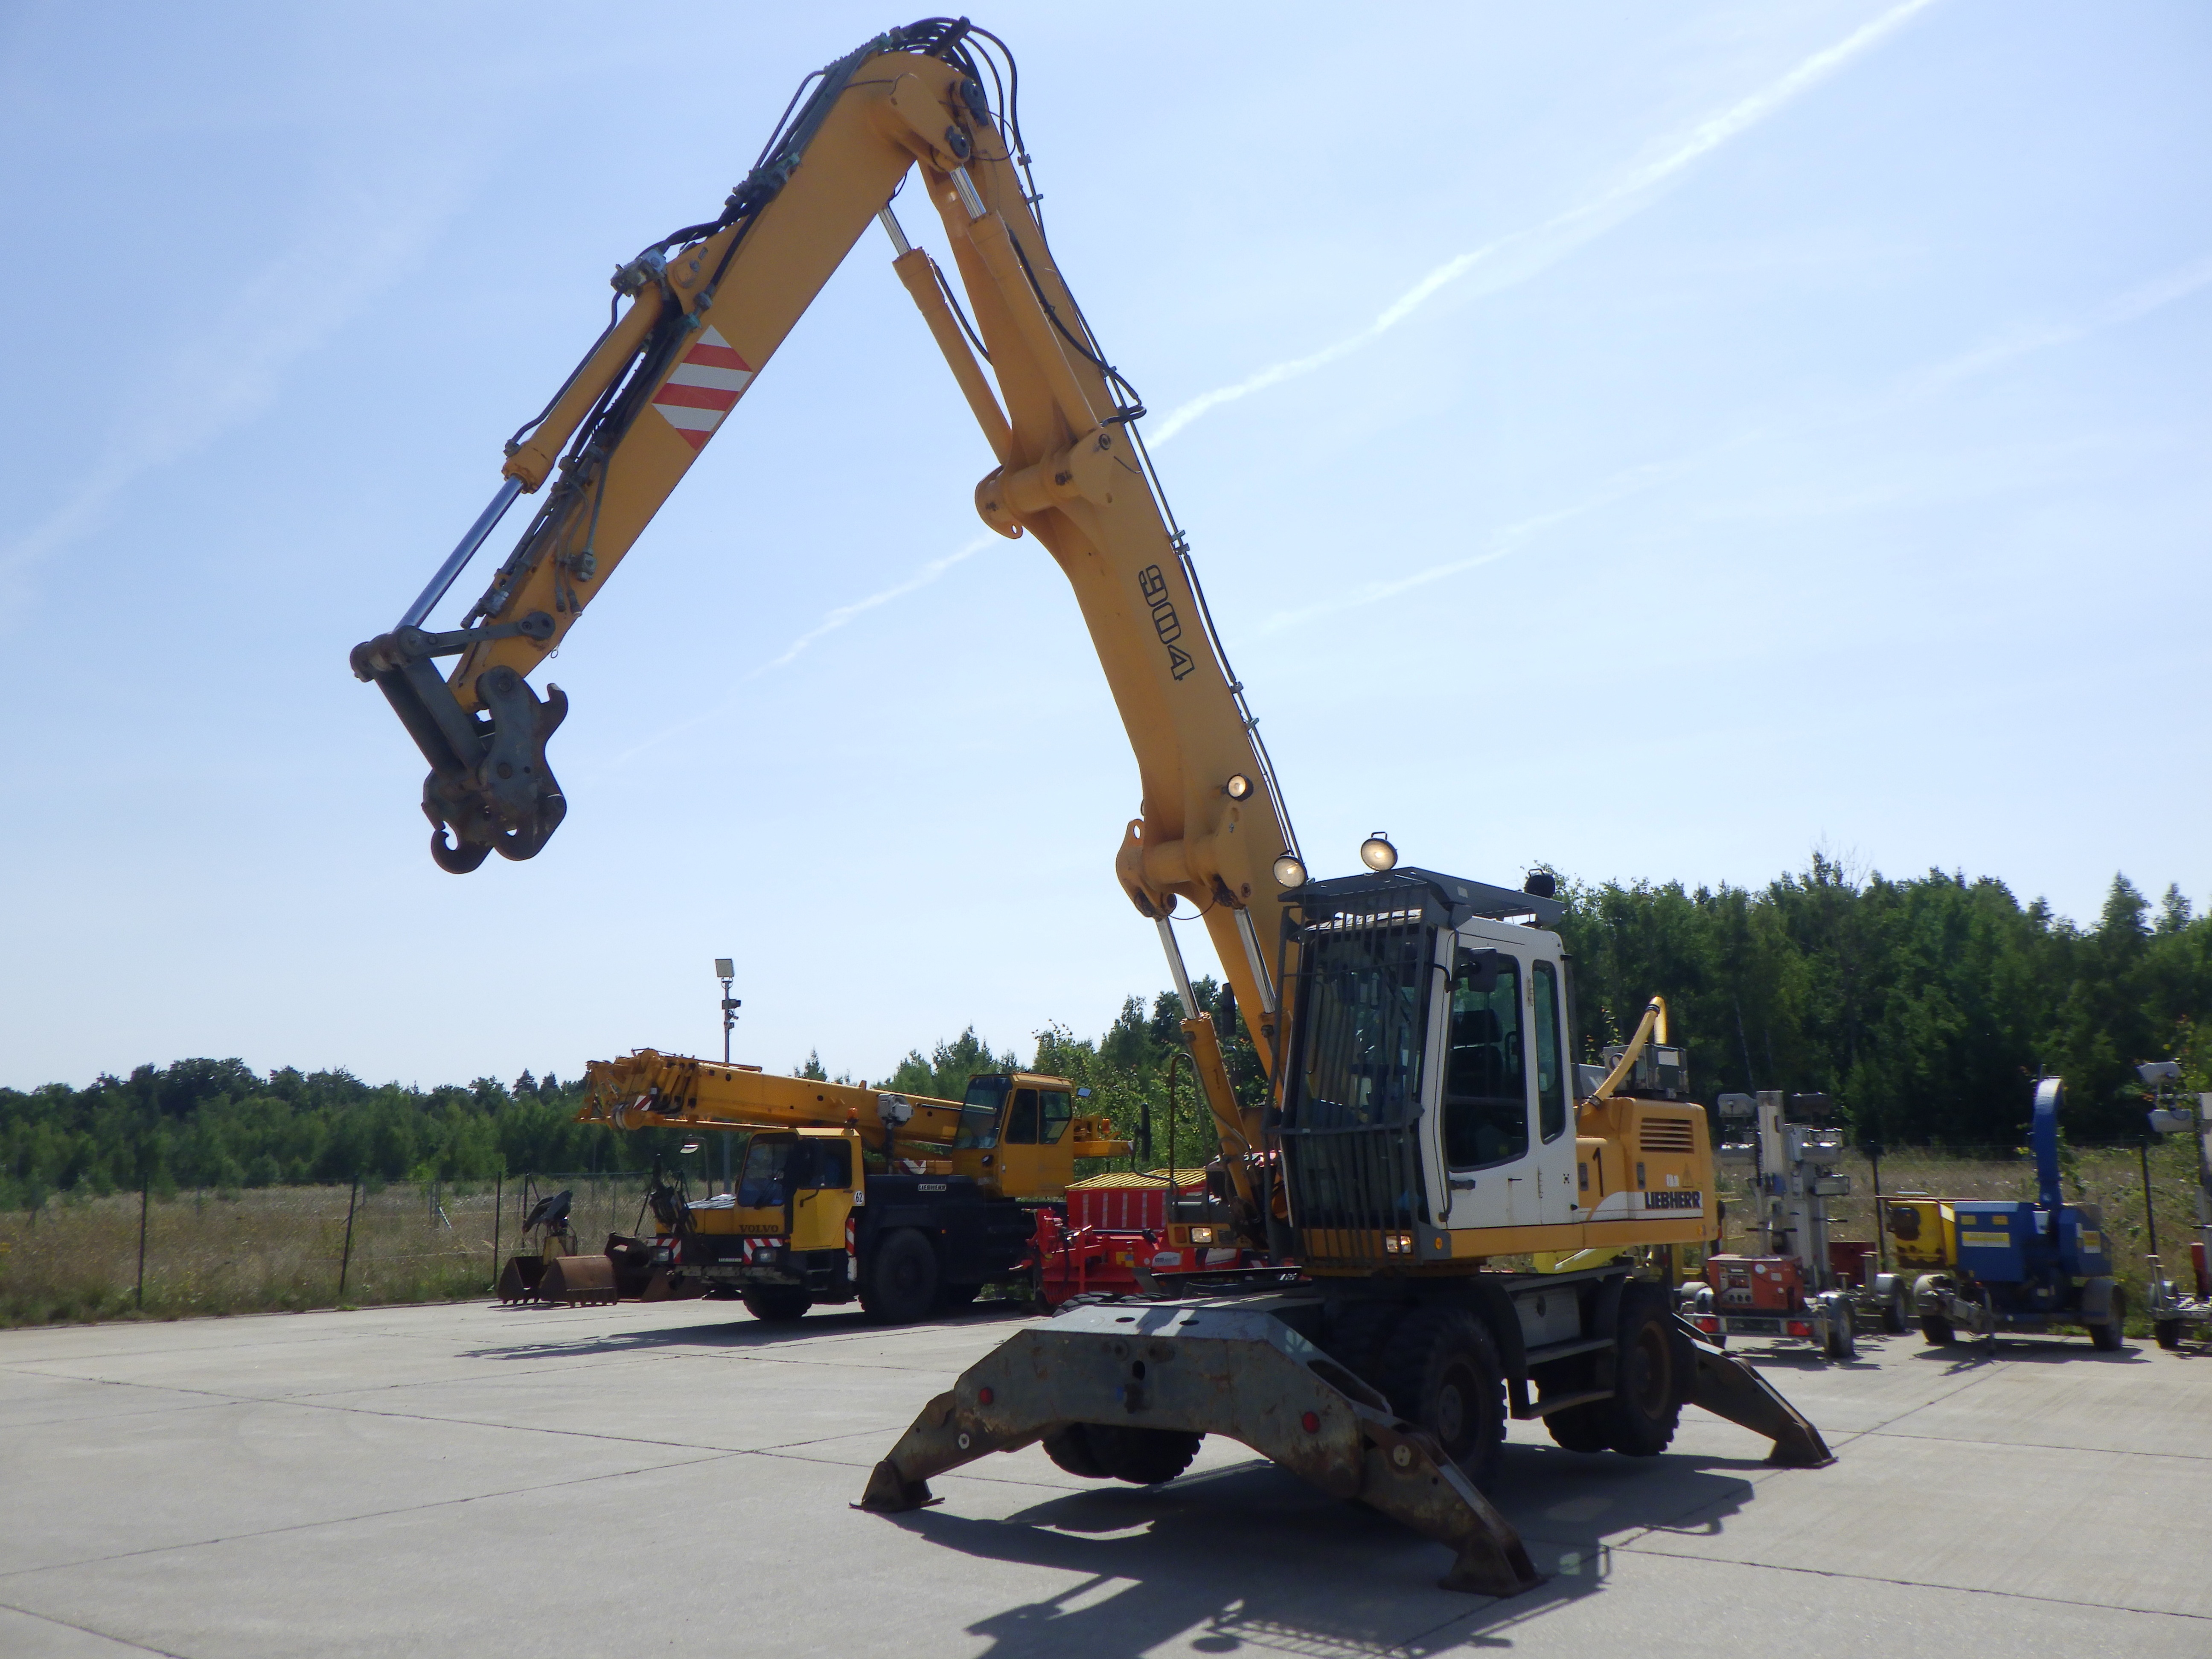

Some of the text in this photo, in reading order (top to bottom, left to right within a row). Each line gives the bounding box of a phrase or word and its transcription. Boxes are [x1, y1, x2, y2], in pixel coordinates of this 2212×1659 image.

[1138, 564, 1195, 681] 904
[856, 1192, 862, 1202] 62
[1645, 1191, 1700, 1209] LIEBHERR
[739, 1224, 779, 1233] VOLVO
